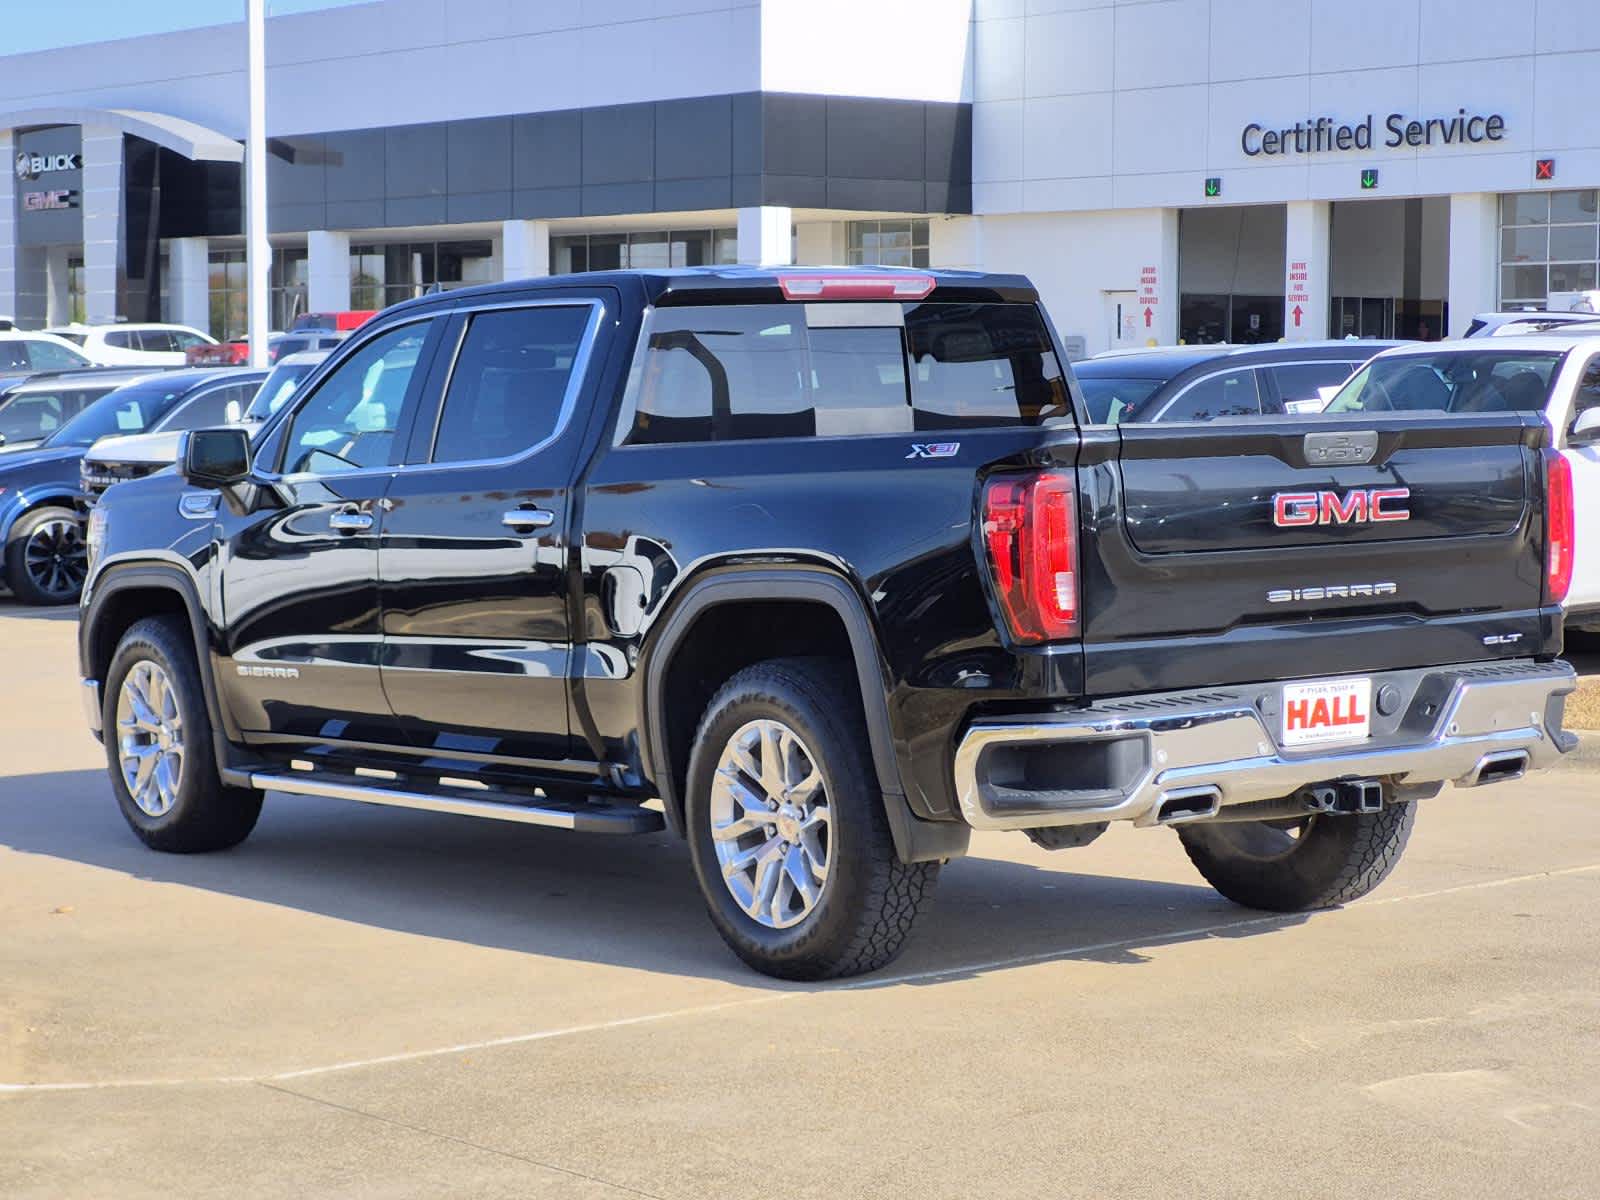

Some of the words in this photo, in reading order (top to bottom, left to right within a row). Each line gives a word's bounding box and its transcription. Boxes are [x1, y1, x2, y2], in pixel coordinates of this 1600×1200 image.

[1241, 114, 1372, 156] Certified
[1385, 108, 1505, 148] Service
[31, 153, 76, 172] BUICK
[24, 190, 70, 210] GMC
[1273, 487, 1410, 527] GMC
[1266, 582, 1397, 603] SIERRA
[1482, 633, 1523, 645] SLT
[236, 665, 300, 679] SIERRA
[1287, 694, 1366, 730] HALL
